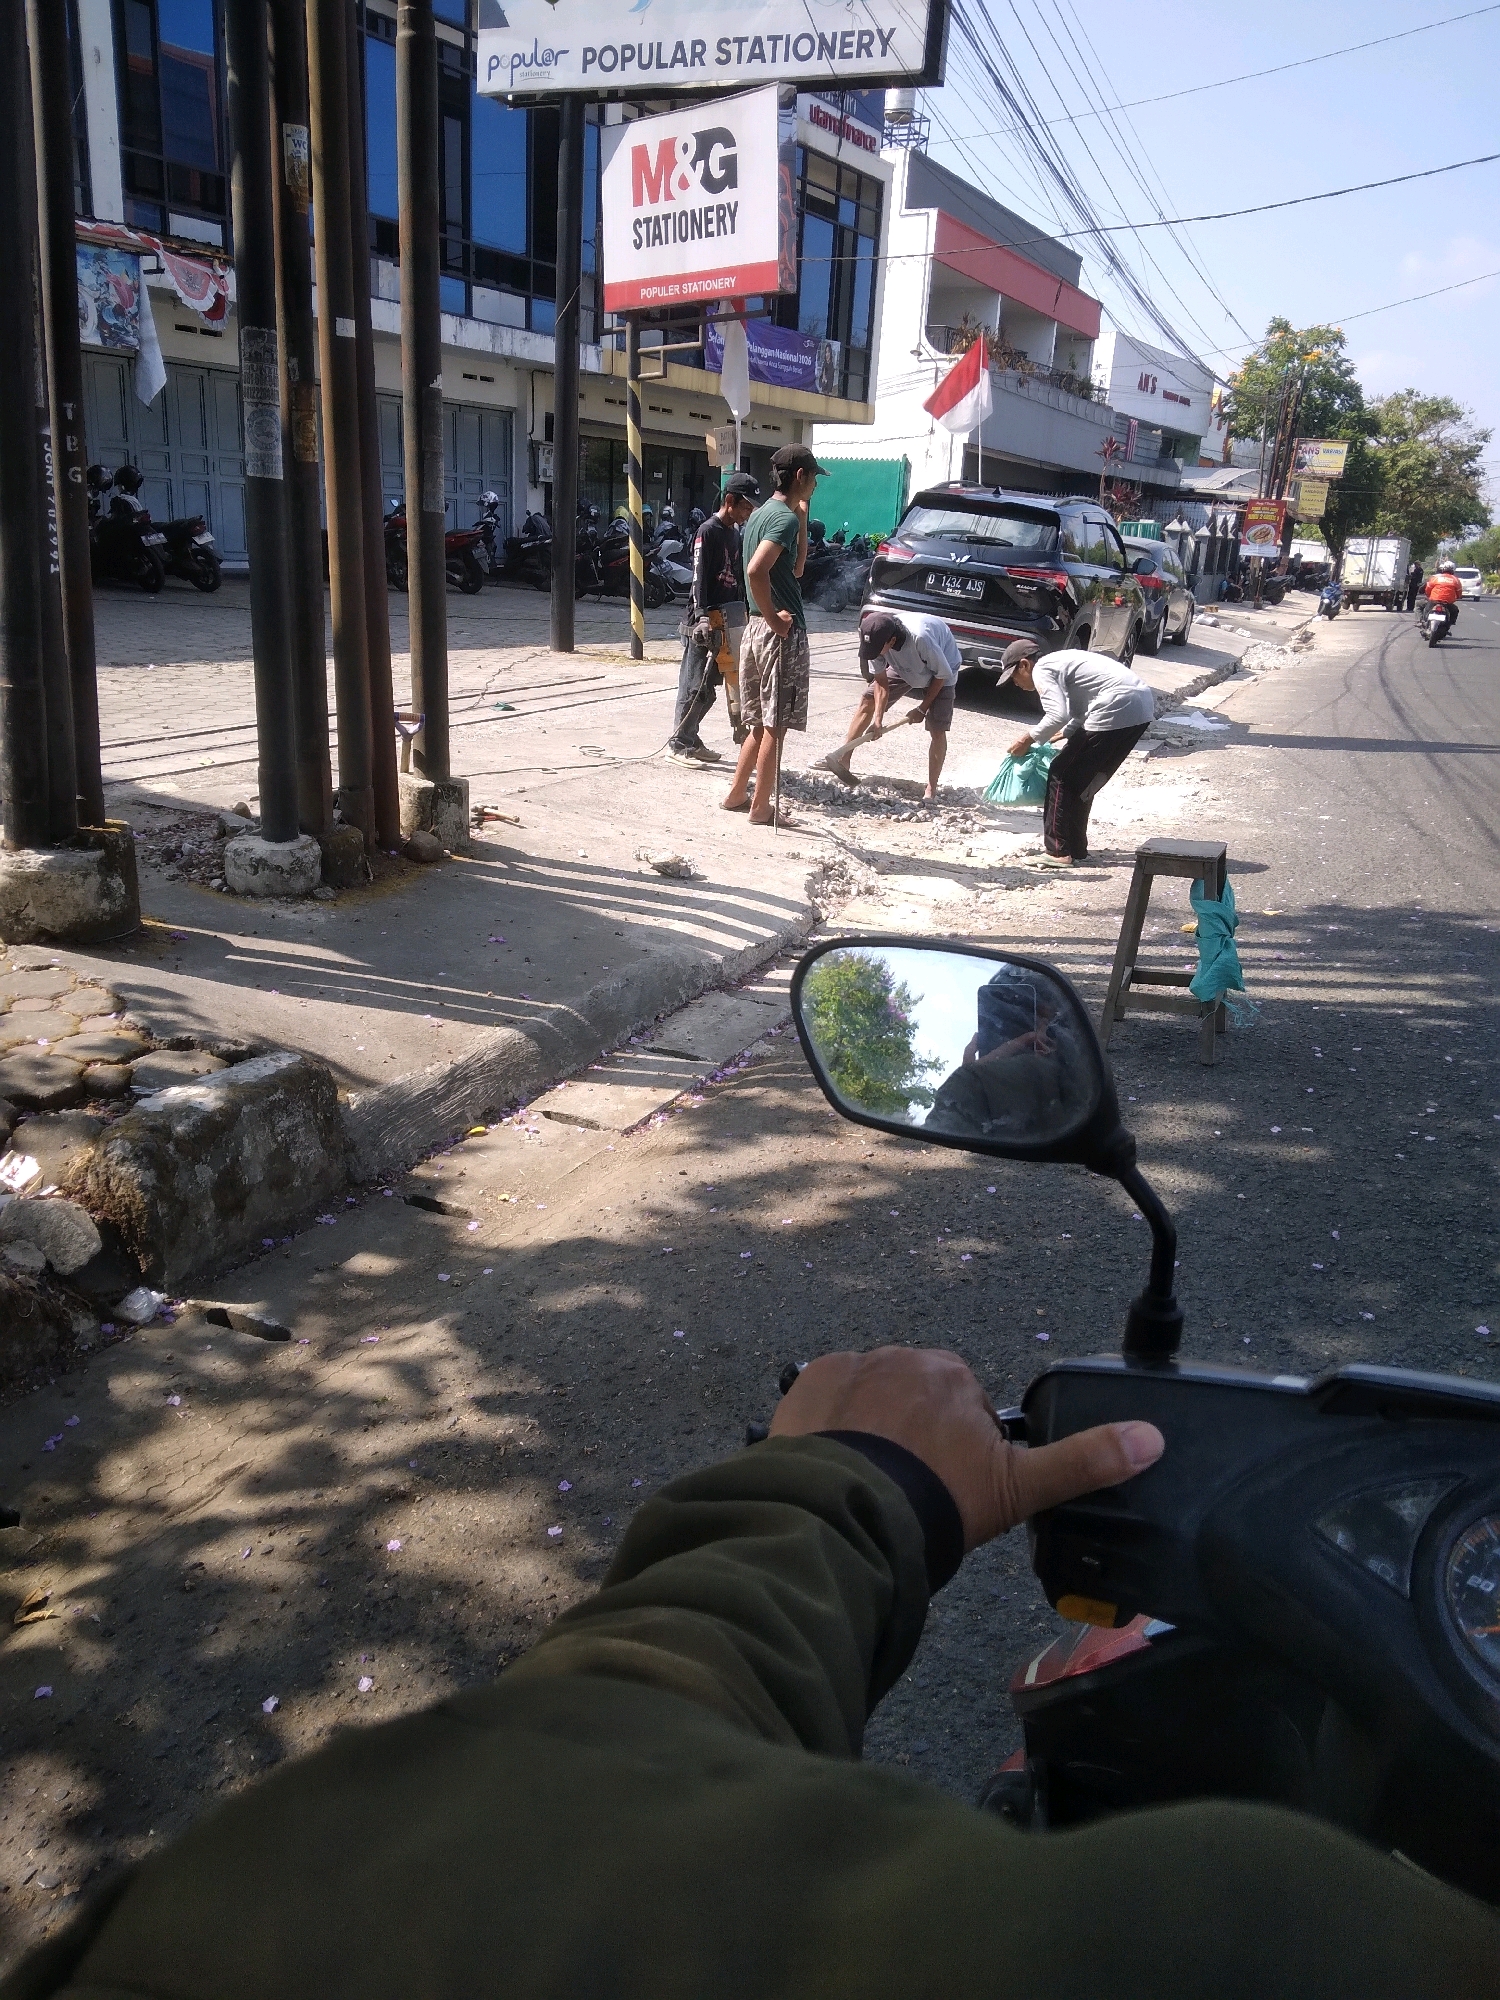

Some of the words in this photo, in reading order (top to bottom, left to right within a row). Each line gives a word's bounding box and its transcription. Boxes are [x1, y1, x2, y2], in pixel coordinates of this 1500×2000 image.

[581, 40, 707, 74] POPULAR
[715, 28, 896, 65] STATIONERY
[520, 70, 551, 78] stationery
[631, 126, 738, 208] M&G
[632, 200, 739, 251] STATIONERY
[640, 284, 680, 299] POPULER
[682, 276, 737, 295] STATIONERY
[941, 575, 961, 588] 1434
[965, 579, 983, 592] AJS
